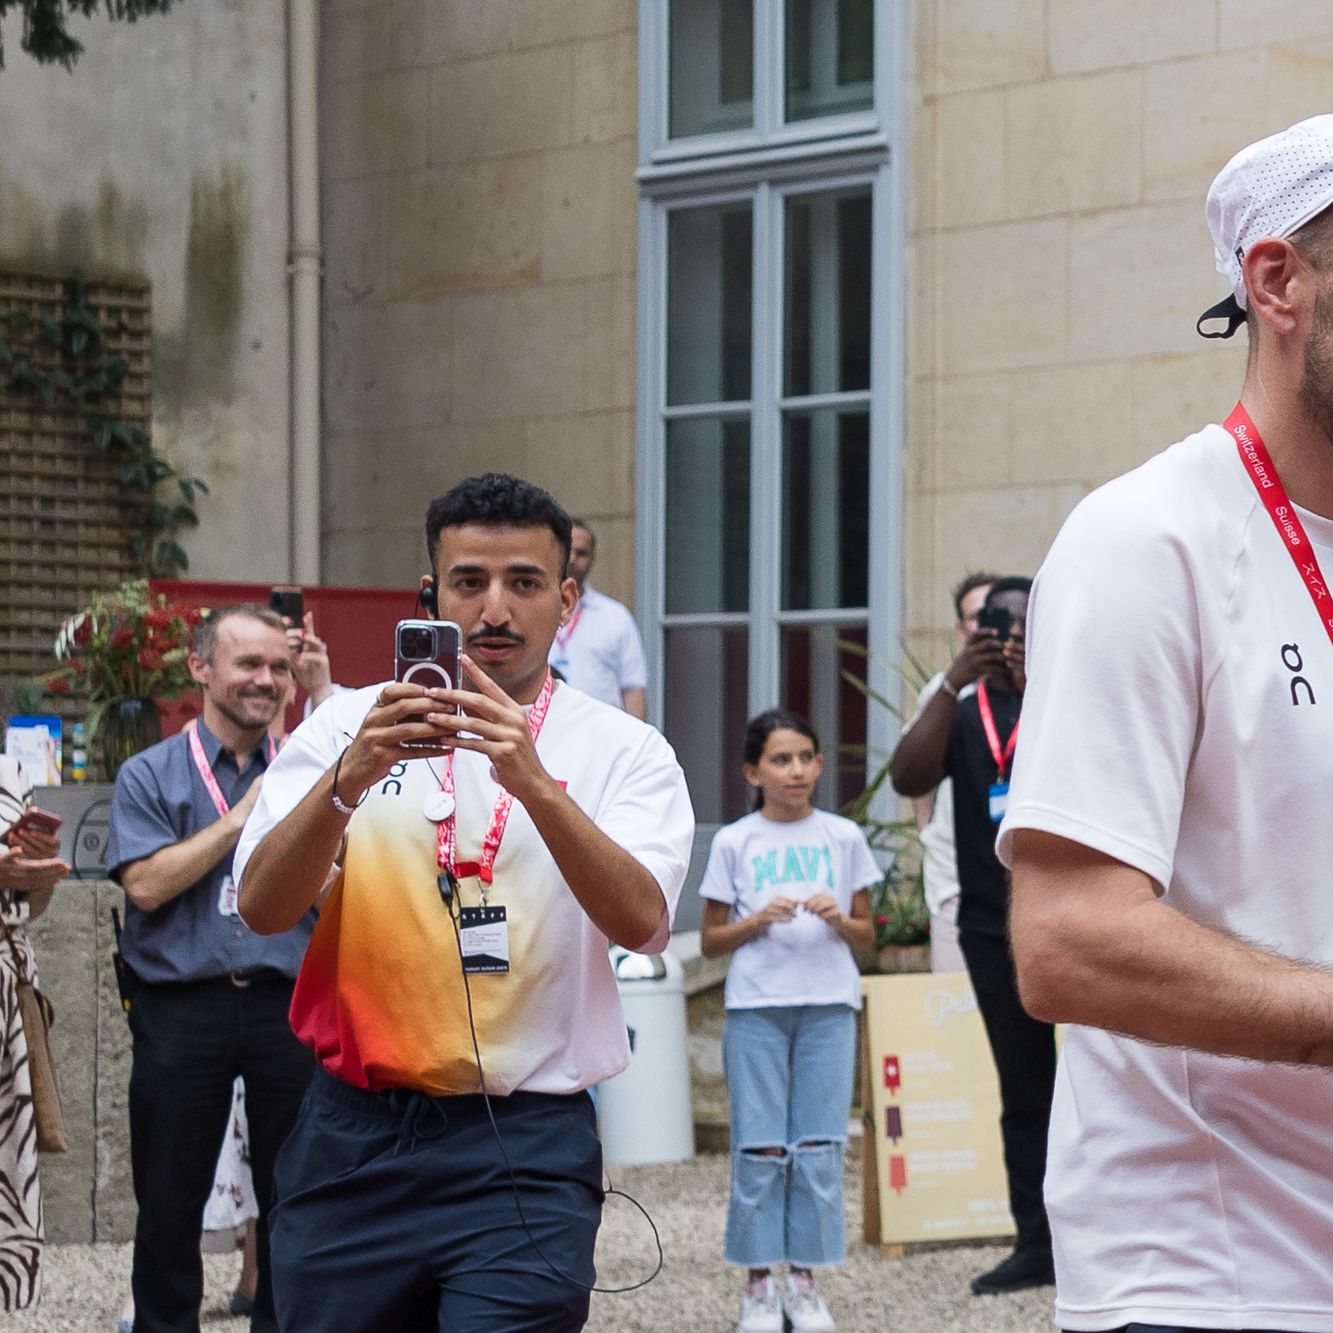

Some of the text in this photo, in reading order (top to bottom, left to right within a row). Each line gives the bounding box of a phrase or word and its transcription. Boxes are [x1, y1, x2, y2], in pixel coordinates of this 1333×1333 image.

[1233, 424, 1274, 490] Switzerland
[1275, 505, 1301, 546] Suisse
[1302, 562, 1326, 599] スイス
